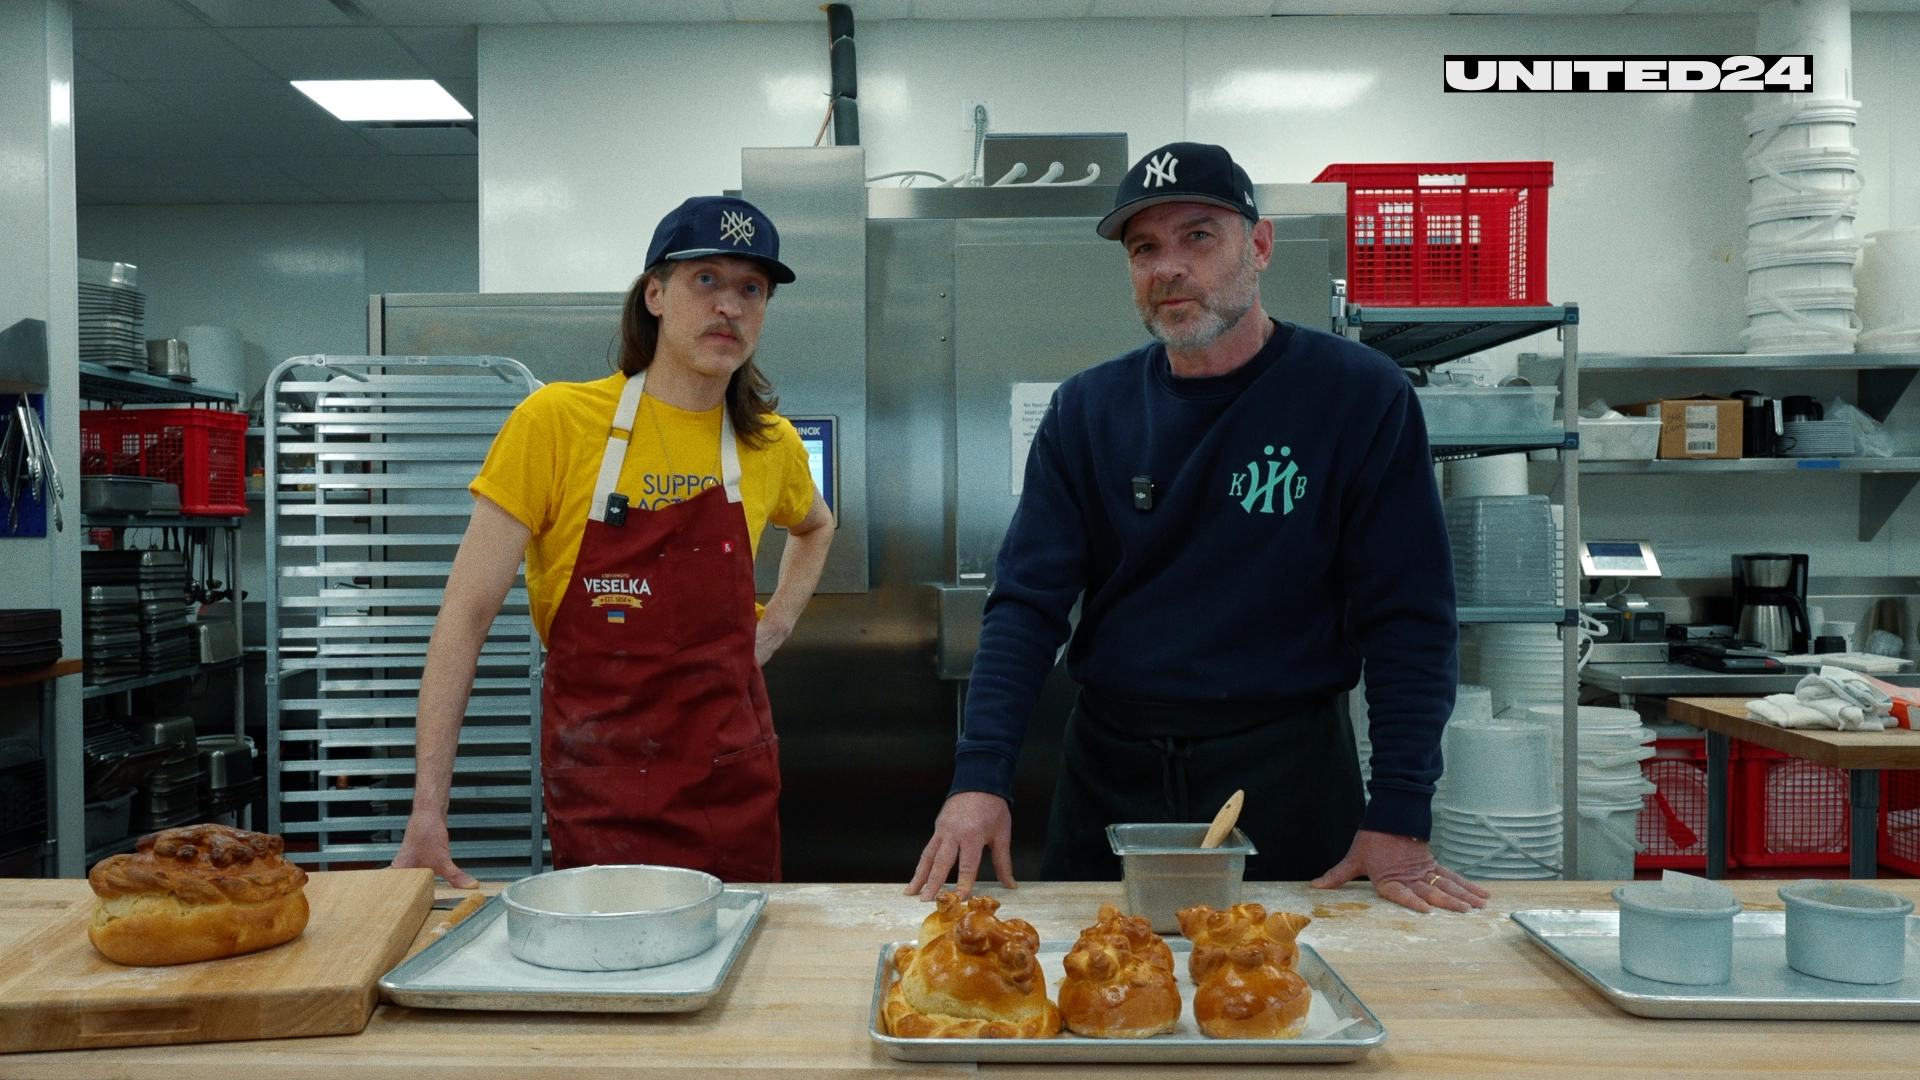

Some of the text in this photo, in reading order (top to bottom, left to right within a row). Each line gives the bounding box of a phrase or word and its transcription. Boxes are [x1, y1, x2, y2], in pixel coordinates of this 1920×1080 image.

[1143, 151, 1179, 188] NY
[643, 474, 723, 495] SUPPO
[583, 577, 652, 596] VESELKA
